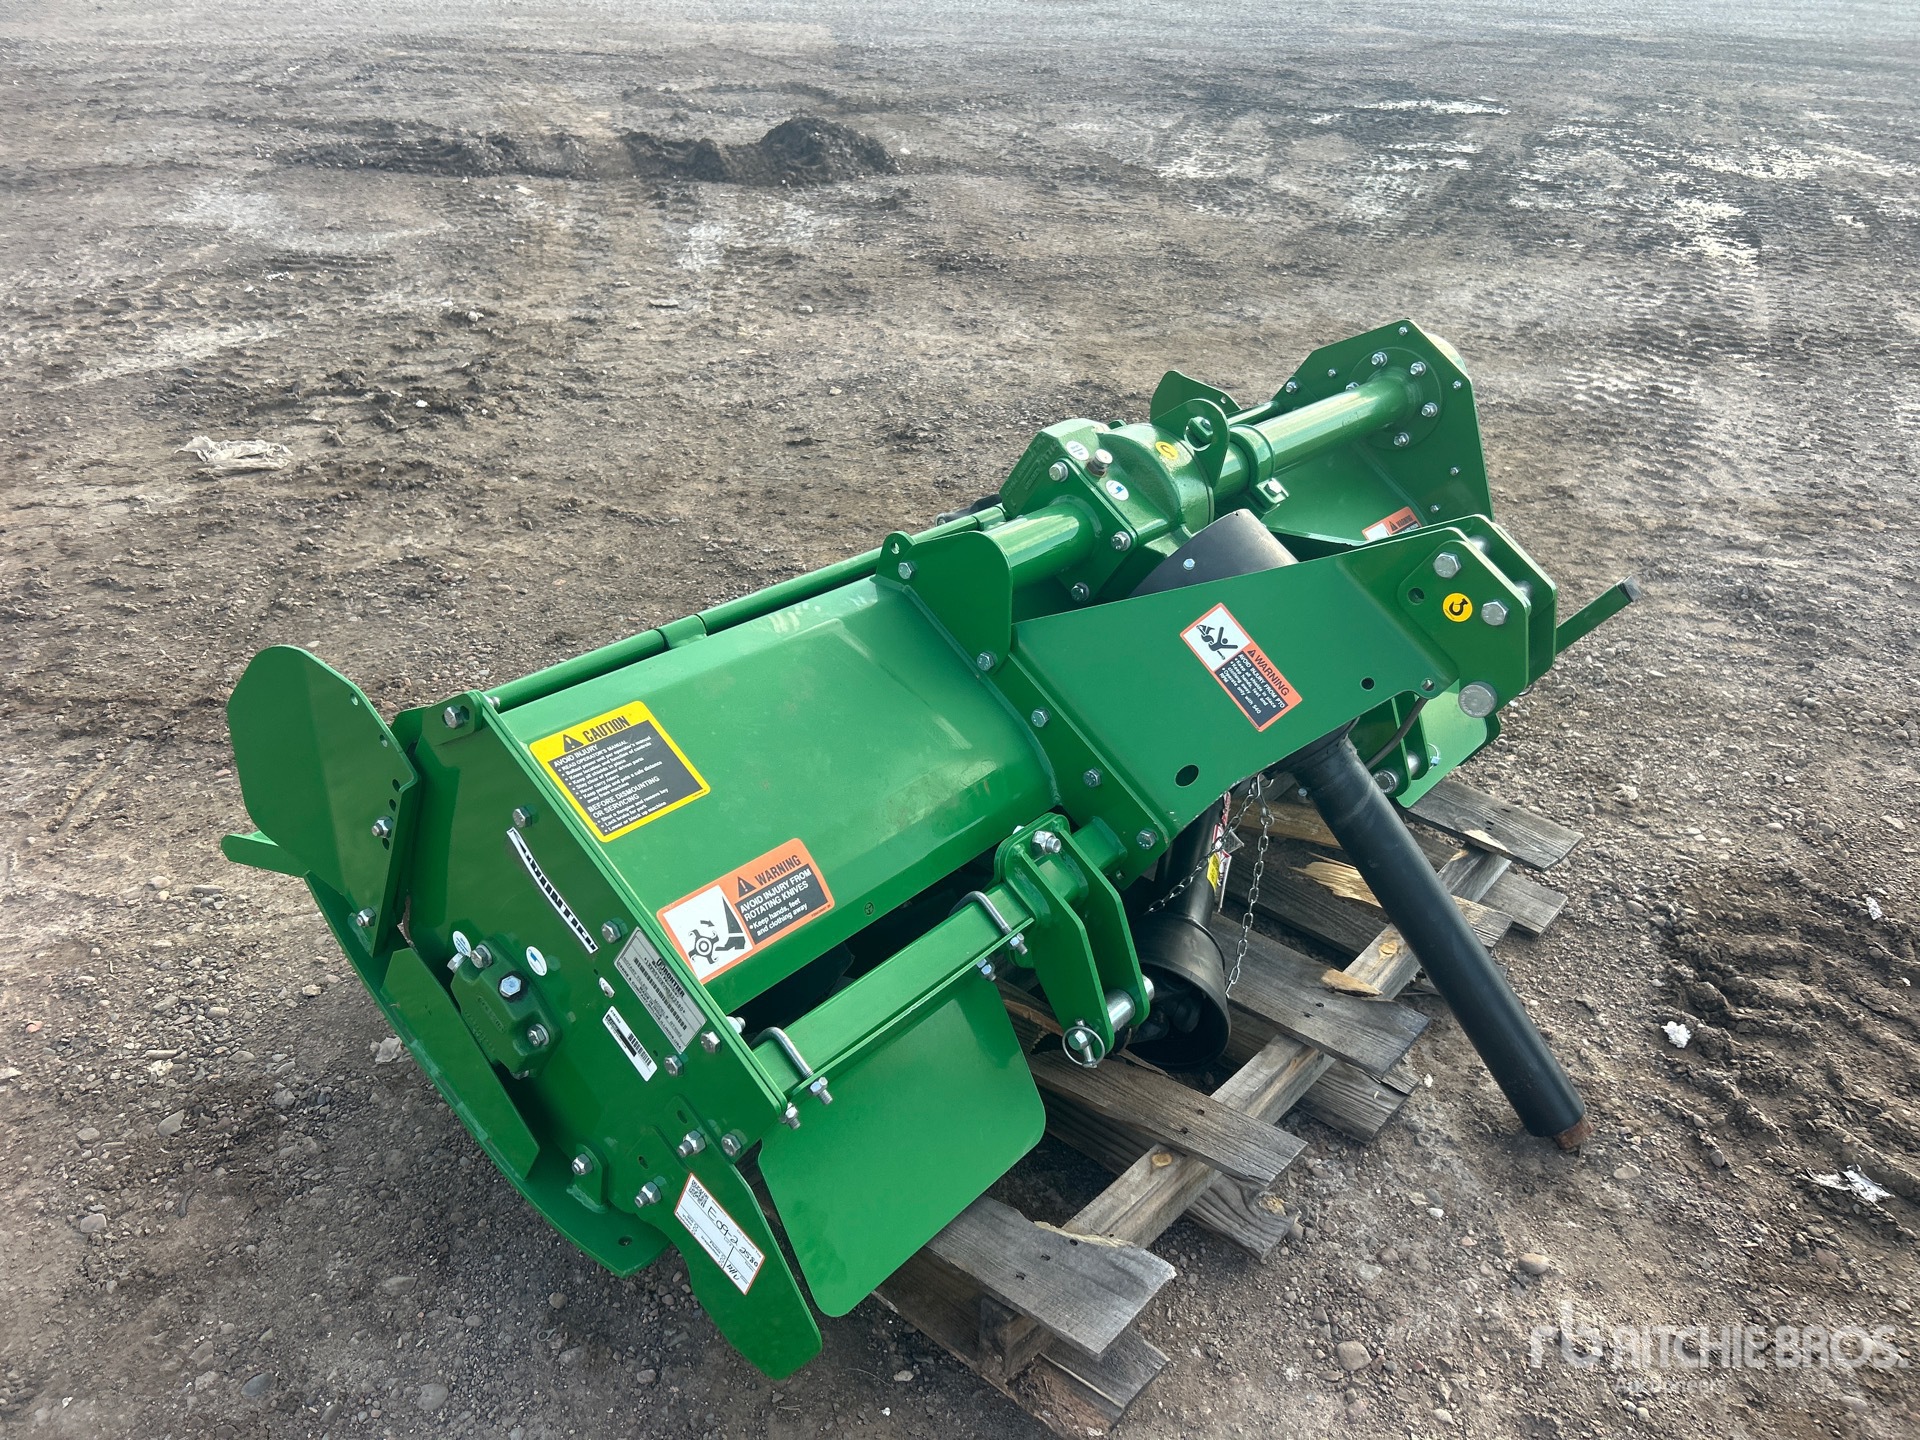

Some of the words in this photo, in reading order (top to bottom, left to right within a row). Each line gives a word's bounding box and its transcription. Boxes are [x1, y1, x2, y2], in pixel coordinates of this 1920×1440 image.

[1228, 667, 1242, 683] clothing
[1241, 683, 1251, 693] away
[1232, 663, 1241, 674] Keep
[1252, 688, 1261, 697] feet
[1236, 660, 1245, 671] Keep
[1250, 677, 1262, 691] shields
[1265, 697, 1276, 708] place
[1238, 654, 1251, 667] AVOID
[1250, 667, 1265, 683] INJURY
[1263, 684, 1277, 698] FROM
[1275, 698, 1285, 708] PTO
[1255, 654, 1290, 696] WARNING
[1224, 670, 1237, 686] Operate
[1237, 687, 1245, 695] only
[1245, 696, 1253, 705] with
[1252, 704, 1261, 713] 540
[582, 715, 630, 742] CAUTION
[554, 754, 574, 767] AVOID
[573, 744, 598, 758] INJURY
[561, 762, 576, 770] READ
[576, 748, 607, 764] OPERATOR'S
[607, 740, 628, 751] MANUAL
[565, 766, 582, 775] Ballast
[582, 760, 596, 769] power
[635, 735, 651, 745] manual
[582, 764, 601, 774] location
[609, 752, 628, 762] function
[591, 767, 608, 776] shields
[613, 759, 626, 767] place
[604, 768, 618, 777] power
[632, 757, 644, 765] parts
[579, 786, 593, 794] Never
[606, 774, 619, 782] riders
[582, 791, 596, 799] Keep
[595, 784, 611, 793] people
[644, 761, 662, 771] distance
[587, 796, 616, 812] BEFORE
[614, 776, 660, 799] DISMOUNTING
[610, 782, 629, 792] machine
[592, 810, 604, 818] OR
[603, 793, 639, 813] SERVICING
[601, 814, 613, 822] Shut
[636, 804, 647, 812] park
[647, 801, 666, 812] machine
[755, 854, 801, 885] WARNING
[740, 895, 763, 913] AVOID
[763, 882, 790, 901] INJURY
[789, 869, 812, 889] FROM
[744, 897, 782, 922] ROTATING
[781, 881, 809, 901] KNIVES
[753, 917, 770, 929] Keep
[768, 908, 790, 923] hands,
[789, 898, 801, 910] feet
[757, 925, 770, 936] and
[768, 912, 793, 931] clothing
[792, 903, 807, 916] away
